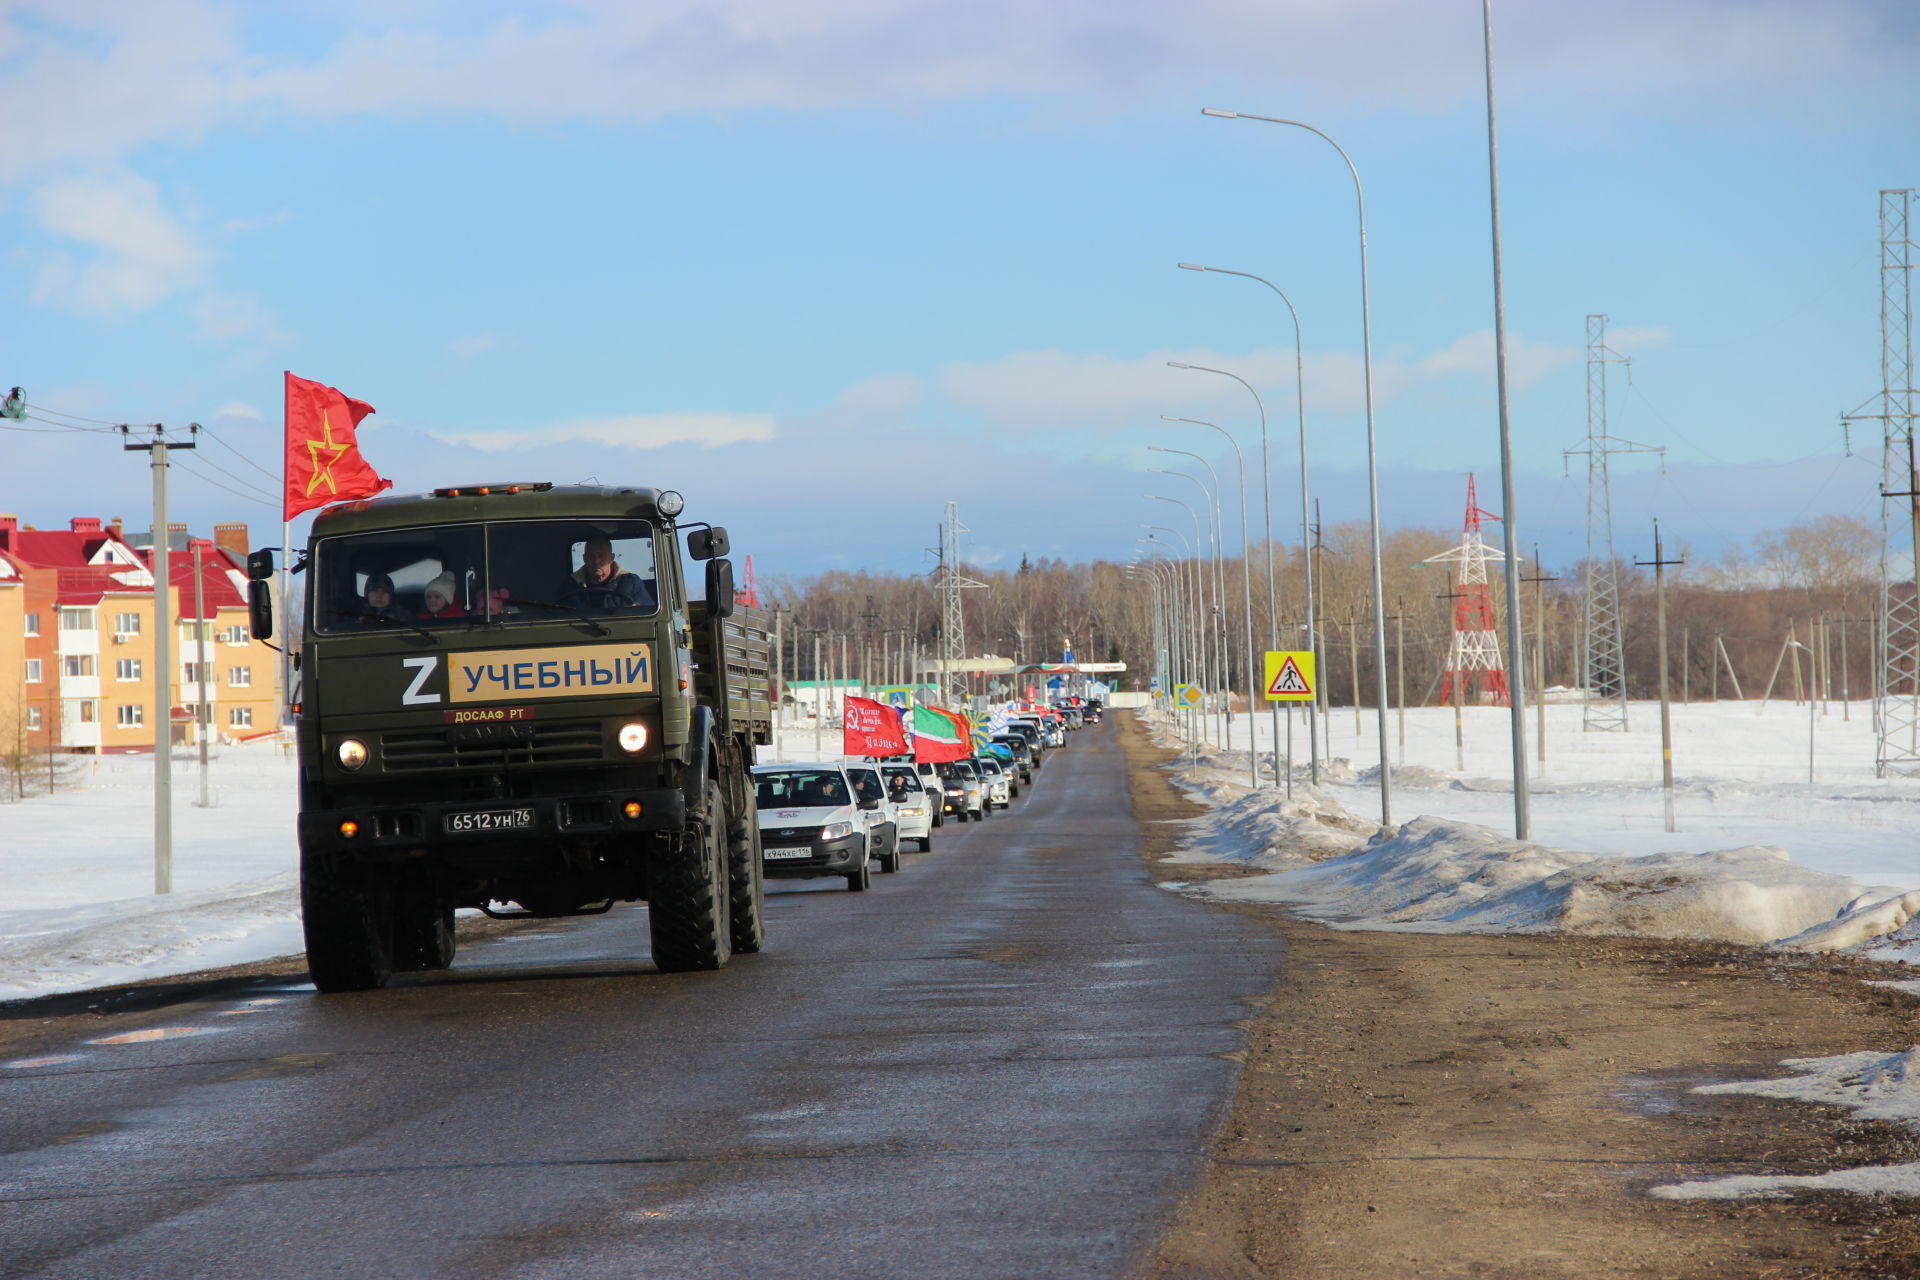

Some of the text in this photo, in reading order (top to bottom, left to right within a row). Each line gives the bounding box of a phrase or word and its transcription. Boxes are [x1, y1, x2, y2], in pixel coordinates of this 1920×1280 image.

[403, 656, 441, 705] Z
[463, 651, 648, 693] УЧЕБНЫЙ
[455, 709, 524, 723] ДОСААФ РТ
